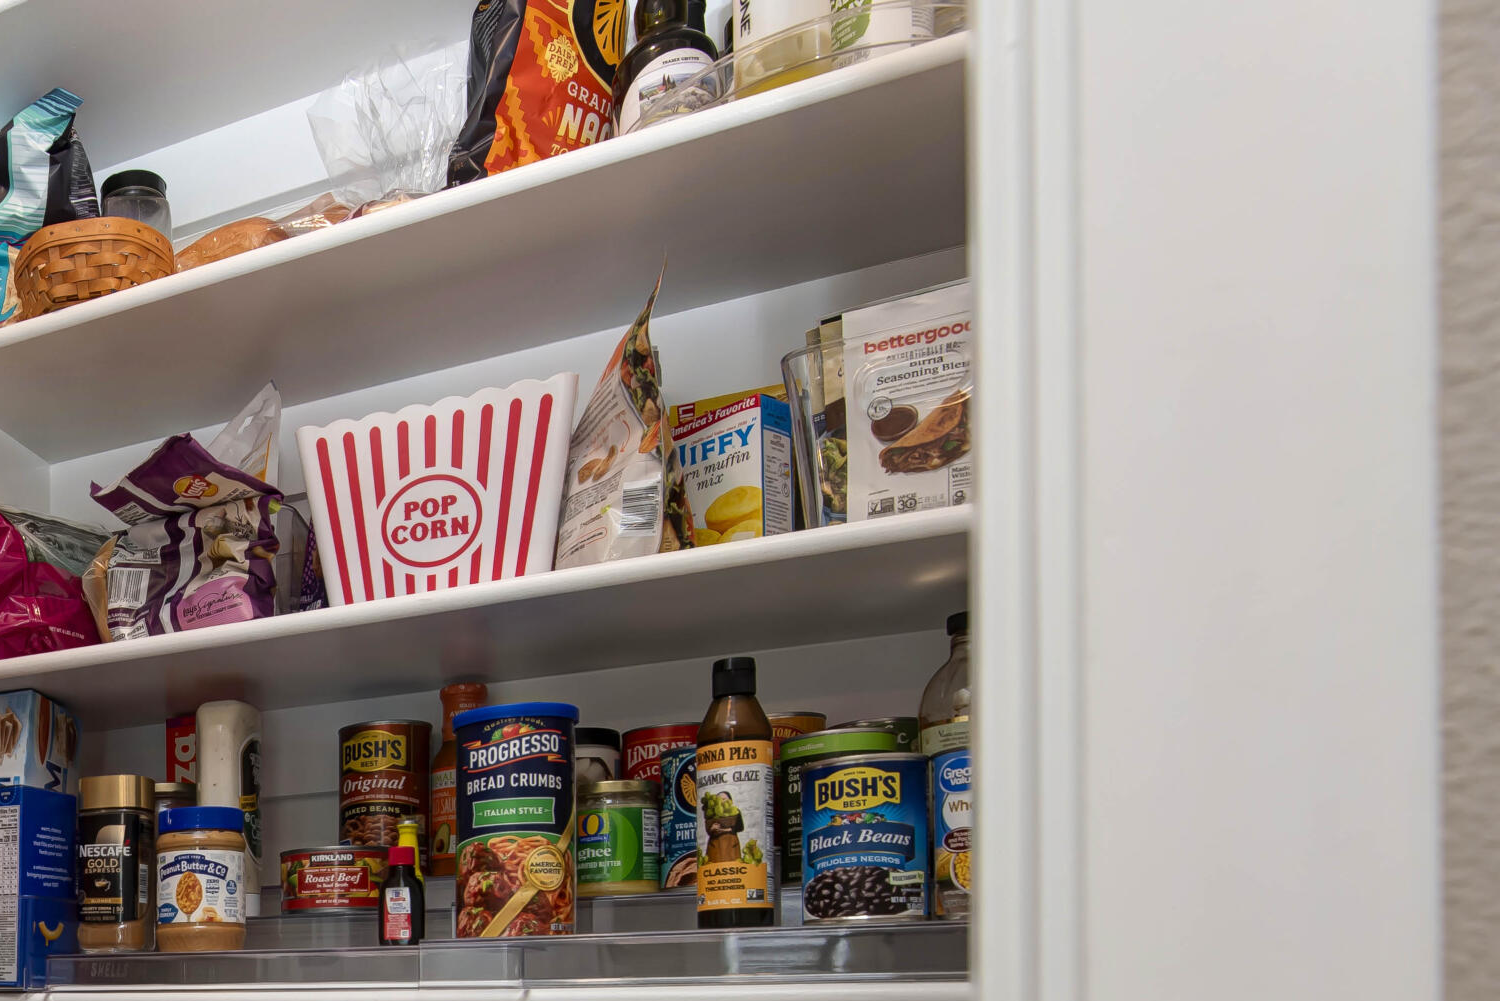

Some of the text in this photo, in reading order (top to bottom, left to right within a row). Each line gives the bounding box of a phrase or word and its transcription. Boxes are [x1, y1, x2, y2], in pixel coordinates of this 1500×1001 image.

[548, 43, 578, 67] DAIRY
[549, 55, 574, 73] FREE
[876, 366, 939, 386] Seasoning
[715, 397, 756, 420] Favorite
[684, 450, 750, 483] rn muffin
[697, 473, 723, 491] mix
[403, 494, 458, 521] POP
[391, 515, 469, 545] CORN
[344, 740, 403, 766] BUSH'S
[469, 734, 559, 769] PROGRESSO
[360, 760, 378, 768] BEST
[467, 772, 562, 795] BREAD CRUMBS
[732, 770, 760, 782] GLAZE
[343, 776, 405, 795] Original
[818, 775, 898, 805] BUSH'S
[369, 805, 401, 815] BEANS
[484, 807, 543, 817] ITALIAN STYLE
[843, 800, 867, 808] BEST
[79, 840, 132, 858] NESCAFÉ
[810, 829, 911, 853] Black Beans
[311, 853, 353, 863] KIRKLAND
[578, 846, 612, 861] ghee
[88, 858, 118, 868] GOLD
[160, 864, 181, 879] Peanut
[181, 861, 208, 872] Butter
[208, 863, 215, 873] &
[598, 860, 621, 868] BUTTER
[703, 866, 747, 877] CLASSIC
[817, 855, 900, 871] FRIJOLES NEGROS
[305, 872, 363, 885] Roast Beef
[717, 877, 742, 885] ADDED
